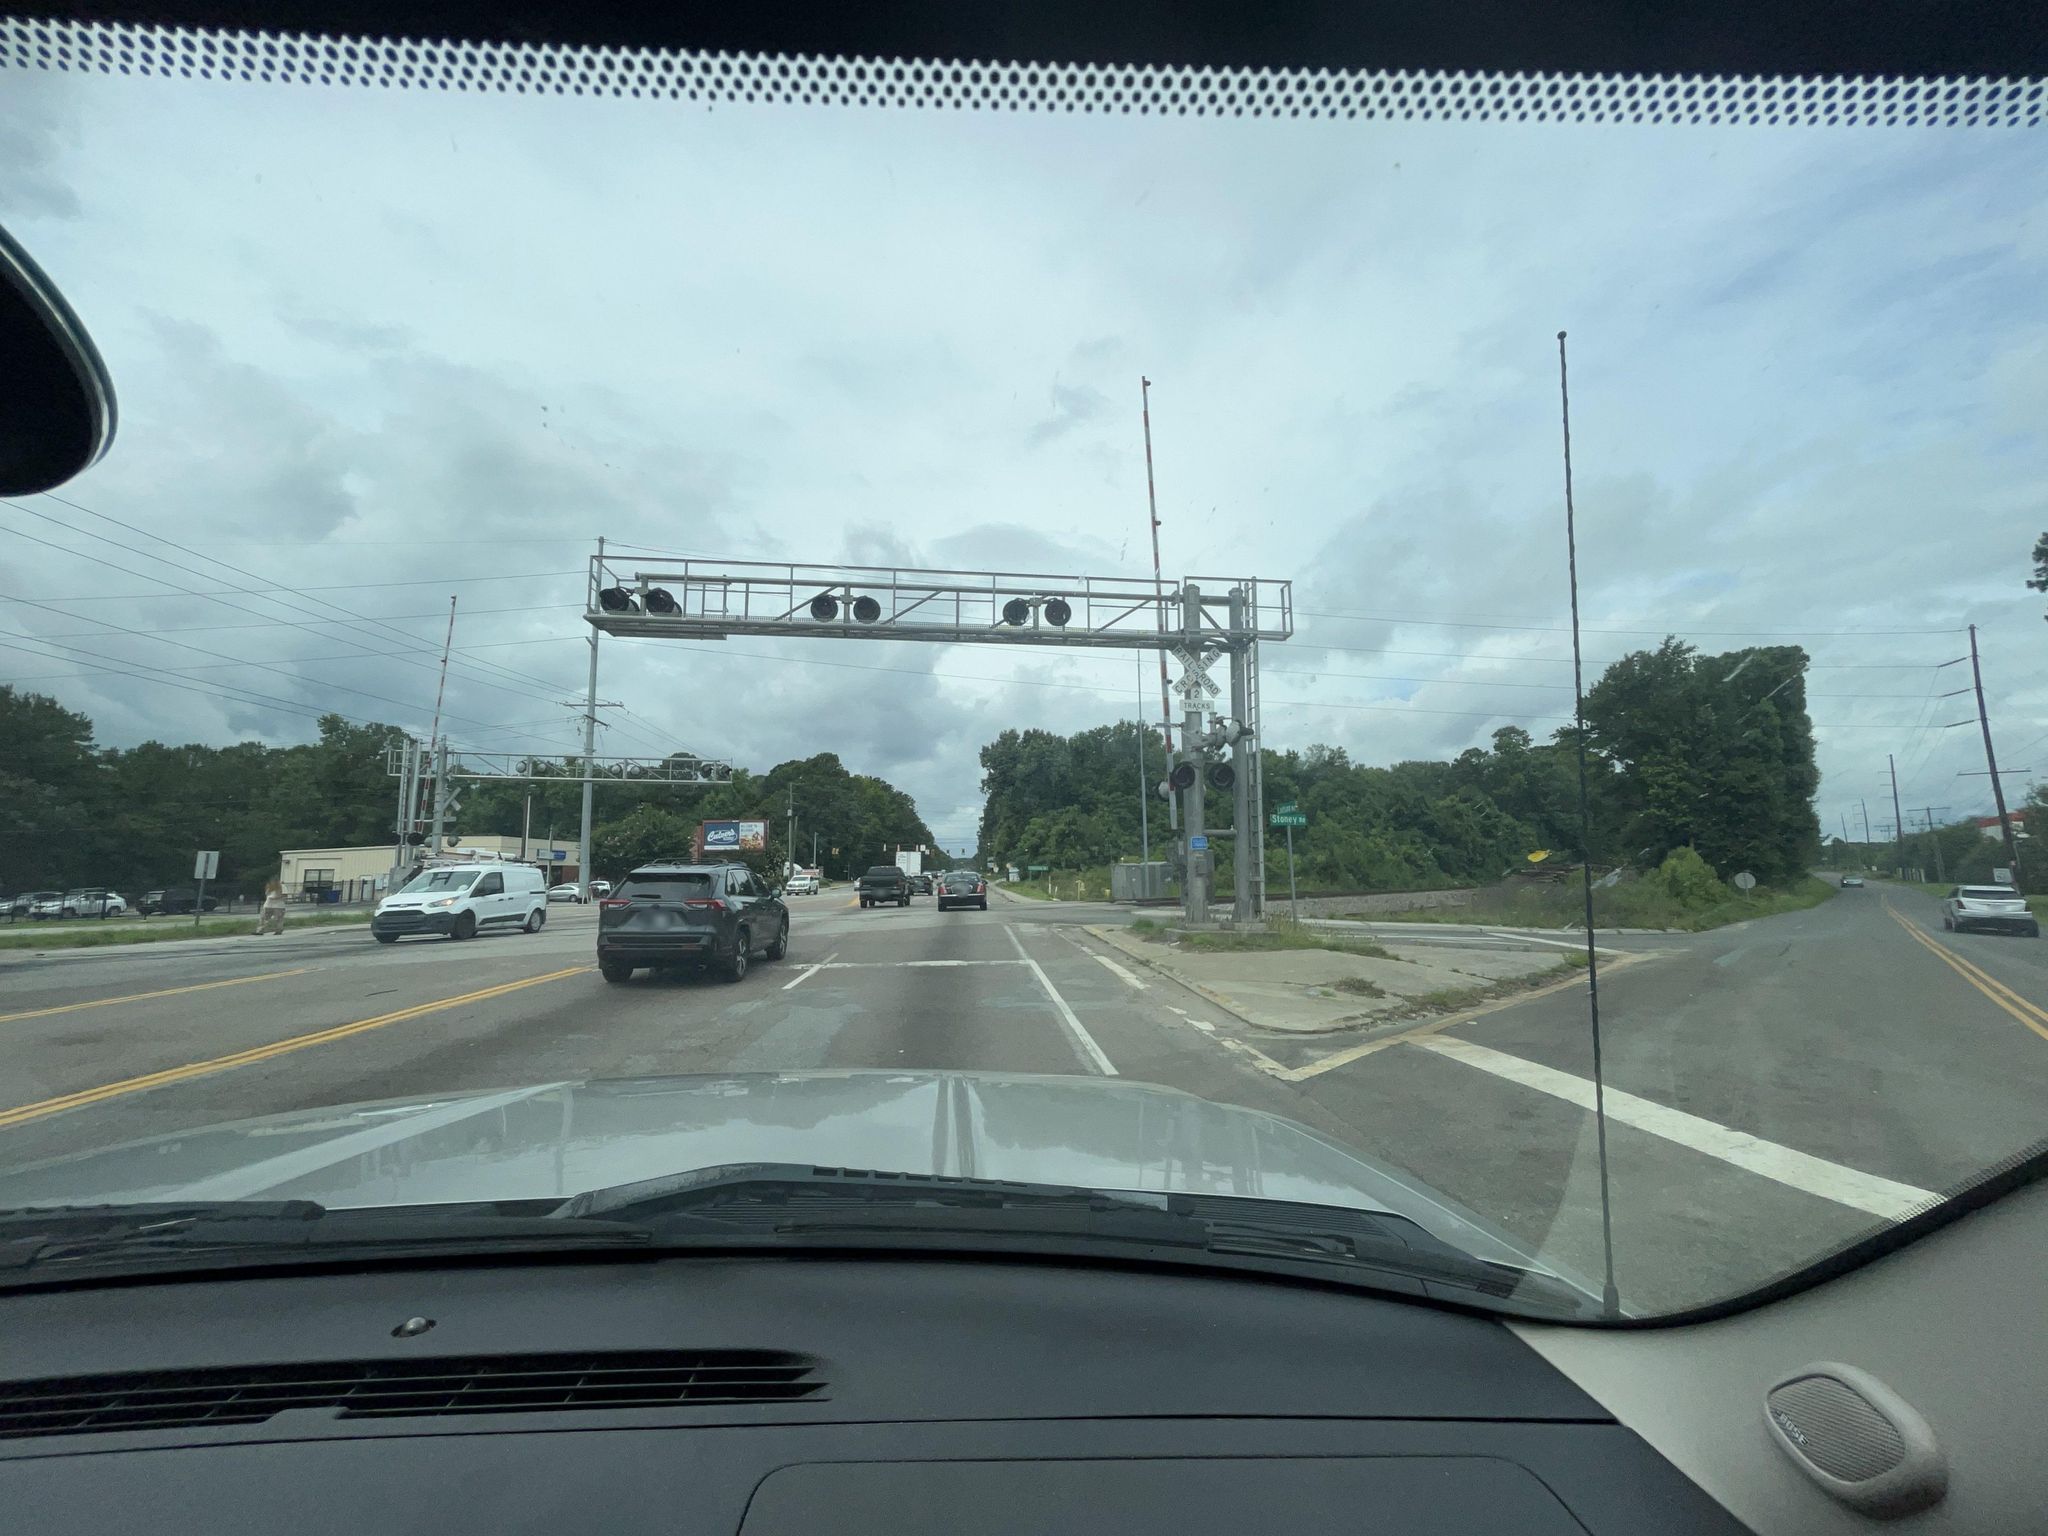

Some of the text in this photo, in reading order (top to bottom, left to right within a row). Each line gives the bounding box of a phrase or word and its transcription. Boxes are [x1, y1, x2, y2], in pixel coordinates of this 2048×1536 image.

[1194, 689, 1200, 699] 2
[1184, 702, 1211, 711] TRACKS
[1272, 814, 1297, 825] Stoney
[1777, 1411, 1809, 1446] BOSE
